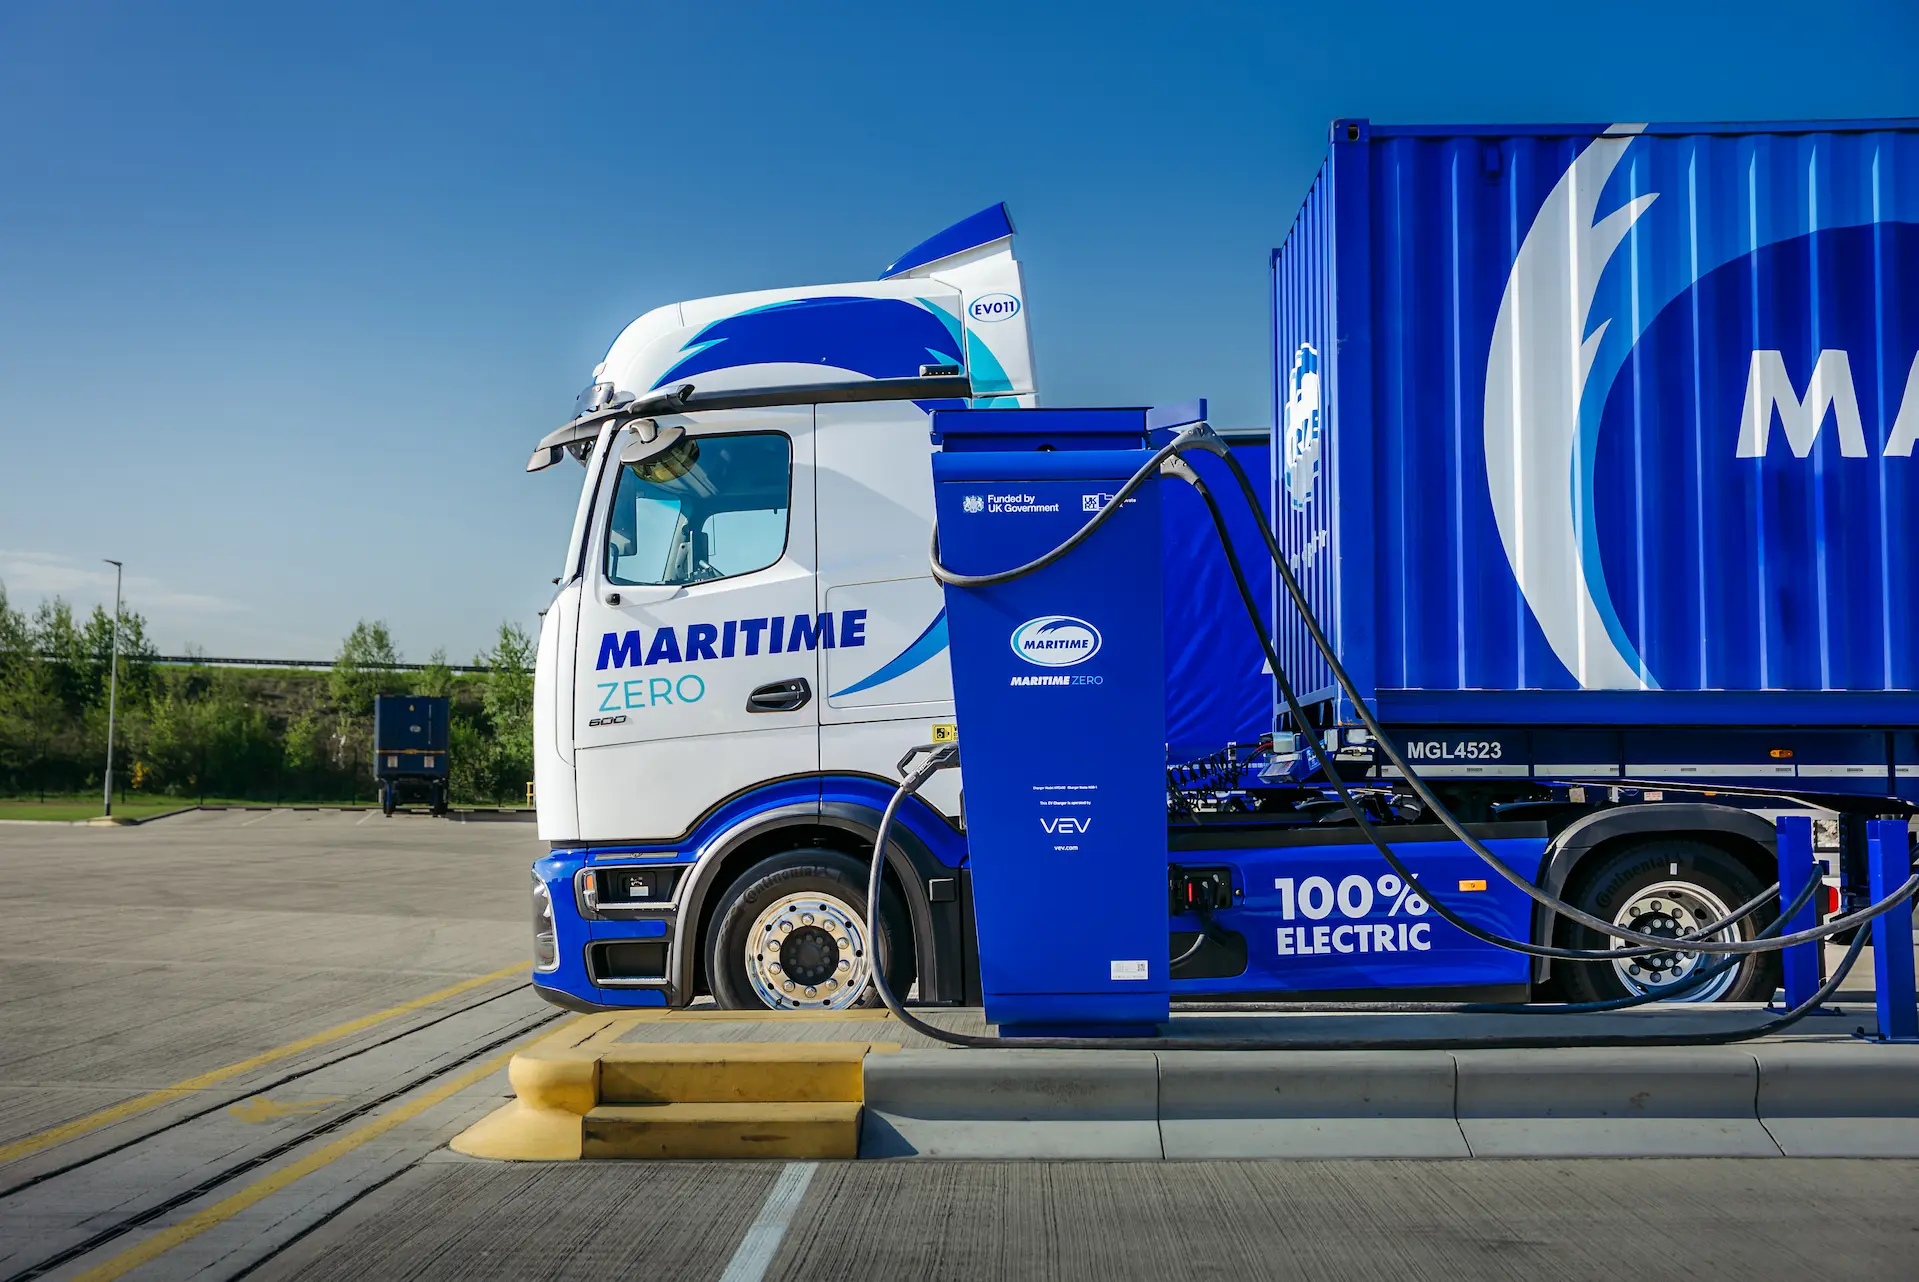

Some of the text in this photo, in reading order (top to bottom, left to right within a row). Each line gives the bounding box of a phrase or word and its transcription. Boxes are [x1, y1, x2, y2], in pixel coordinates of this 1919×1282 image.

[987, 494, 1035, 504] Funded by
[988, 503, 1059, 513] UK Government
[595, 609, 867, 671] MARITIME
[1024, 640, 1089, 649] MARITIME
[1010, 675, 1104, 686] MARITIME ZERO
[597, 674, 705, 712] ZERO
[589, 715, 627, 727] 600
[1407, 741, 1502, 759] MGL4523
[1040, 817, 1091, 833] VEV
[1274, 873, 1429, 920] 100%
[1277, 923, 1431, 955] ELECTRIC
